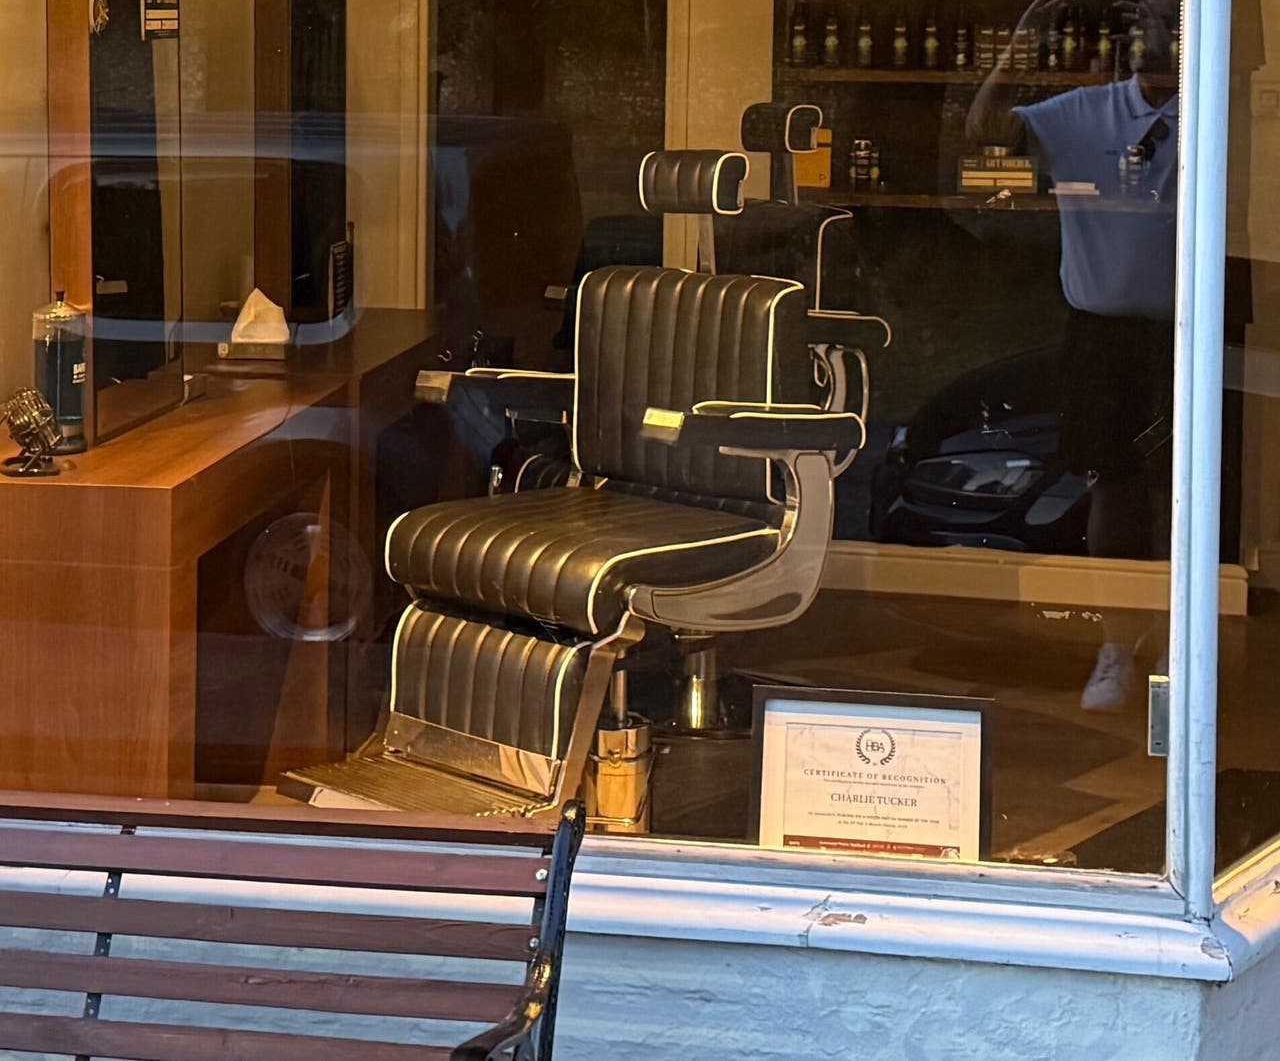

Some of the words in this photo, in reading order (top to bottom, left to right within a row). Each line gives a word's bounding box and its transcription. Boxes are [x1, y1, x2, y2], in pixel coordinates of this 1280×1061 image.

[803, 768, 863, 779] CERTIFICATE
[882, 774, 947, 785] RECOGNITION
[830, 793, 875, 804] CHARLIE
[877, 796, 918, 807] TUCKER
